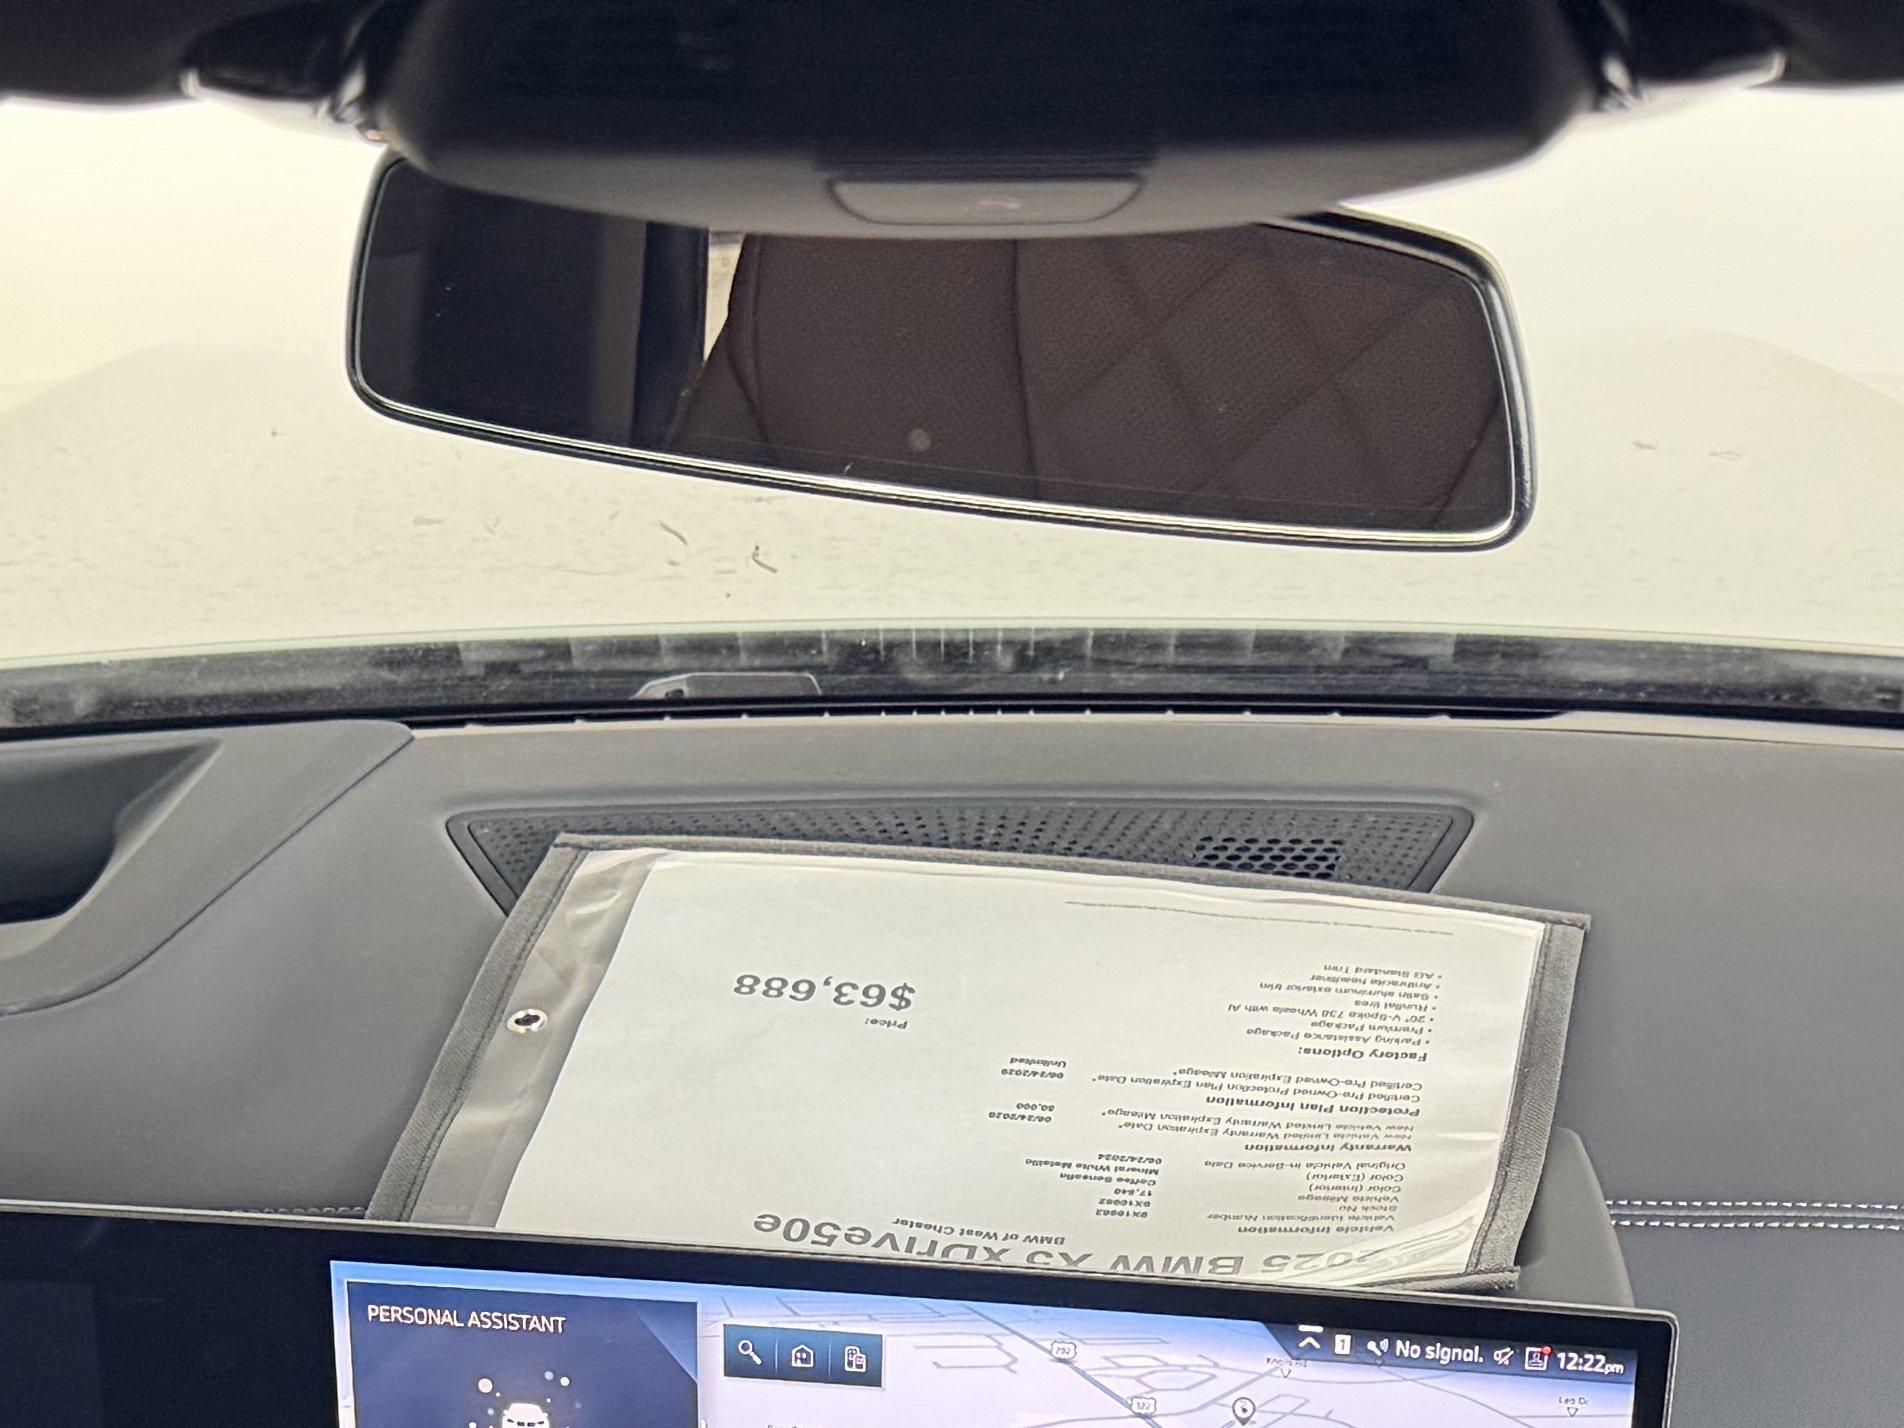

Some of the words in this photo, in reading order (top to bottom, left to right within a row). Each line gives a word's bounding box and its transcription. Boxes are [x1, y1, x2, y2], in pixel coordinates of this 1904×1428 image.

[733, 974, 915, 1011] $63,688
[864, 1018, 908, 1029] Price:
[1310, 1021, 1364, 1032] Package
[1246, 1028, 1299, 1039] Package
[1303, 1032, 1371, 1044] Assistance
[1374, 1035, 1421, 1046] Parking
[1298, 1046, 1364, 1059] Options:
[1368, 1048, 1427, 1062] Factory
[1130, 1077, 1191, 1088] Expiration
[1230, 1071, 1292, 1083] Expiration
[1295, 1076, 1366, 1088] Pre-Owned
[1195, 1081, 1223, 1091] Plan
[1227, 1083, 1289, 1096] Protection
[1371, 1080, 1422, 1091] Certified
[1293, 1088, 1363, 1100] Pre-Owned
[1368, 1092, 1420, 1103] Certified
[1205, 1096, 1295, 1111] Information
[1300, 1102, 1334, 1113] Plan
[1340, 1105, 1420, 1116] Protection
[1225, 1116, 1281, 1129] Warranty
[1244, 1143, 1335, 1152] Information
[1340, 1142, 1412, 1152] Warranty
[1076, 1162, 1110, 1172] White
[1114, 1165, 1159, 1175] Mineral
[1306, 1162, 1352, 1170] Vehicle
[1356, 1162, 1406, 1170] Original
[1116, 1177, 1156, 1186] Coffee
[1369, 1173, 1404, 1182] Color
[1368, 1185, 1401, 1193] Color
[892, 1217, 955, 1236] Chester
[1237, 1226, 1330, 1234] Information
[754, 1214, 1009, 1261] xDrive50e
[958, 1228, 999, 1241] West
[1002, 1233, 1019, 1242] of
[1024, 1234, 1066, 1246] BMW
[1110, 1255, 1244, 1276] BMW
[368, 1305, 464, 1327] PERSONAL
[468, 1312, 566, 1334] ASSISTANT
[1396, 1340, 1420, 1358] No
[1425, 1343, 1484, 1366] signal.
